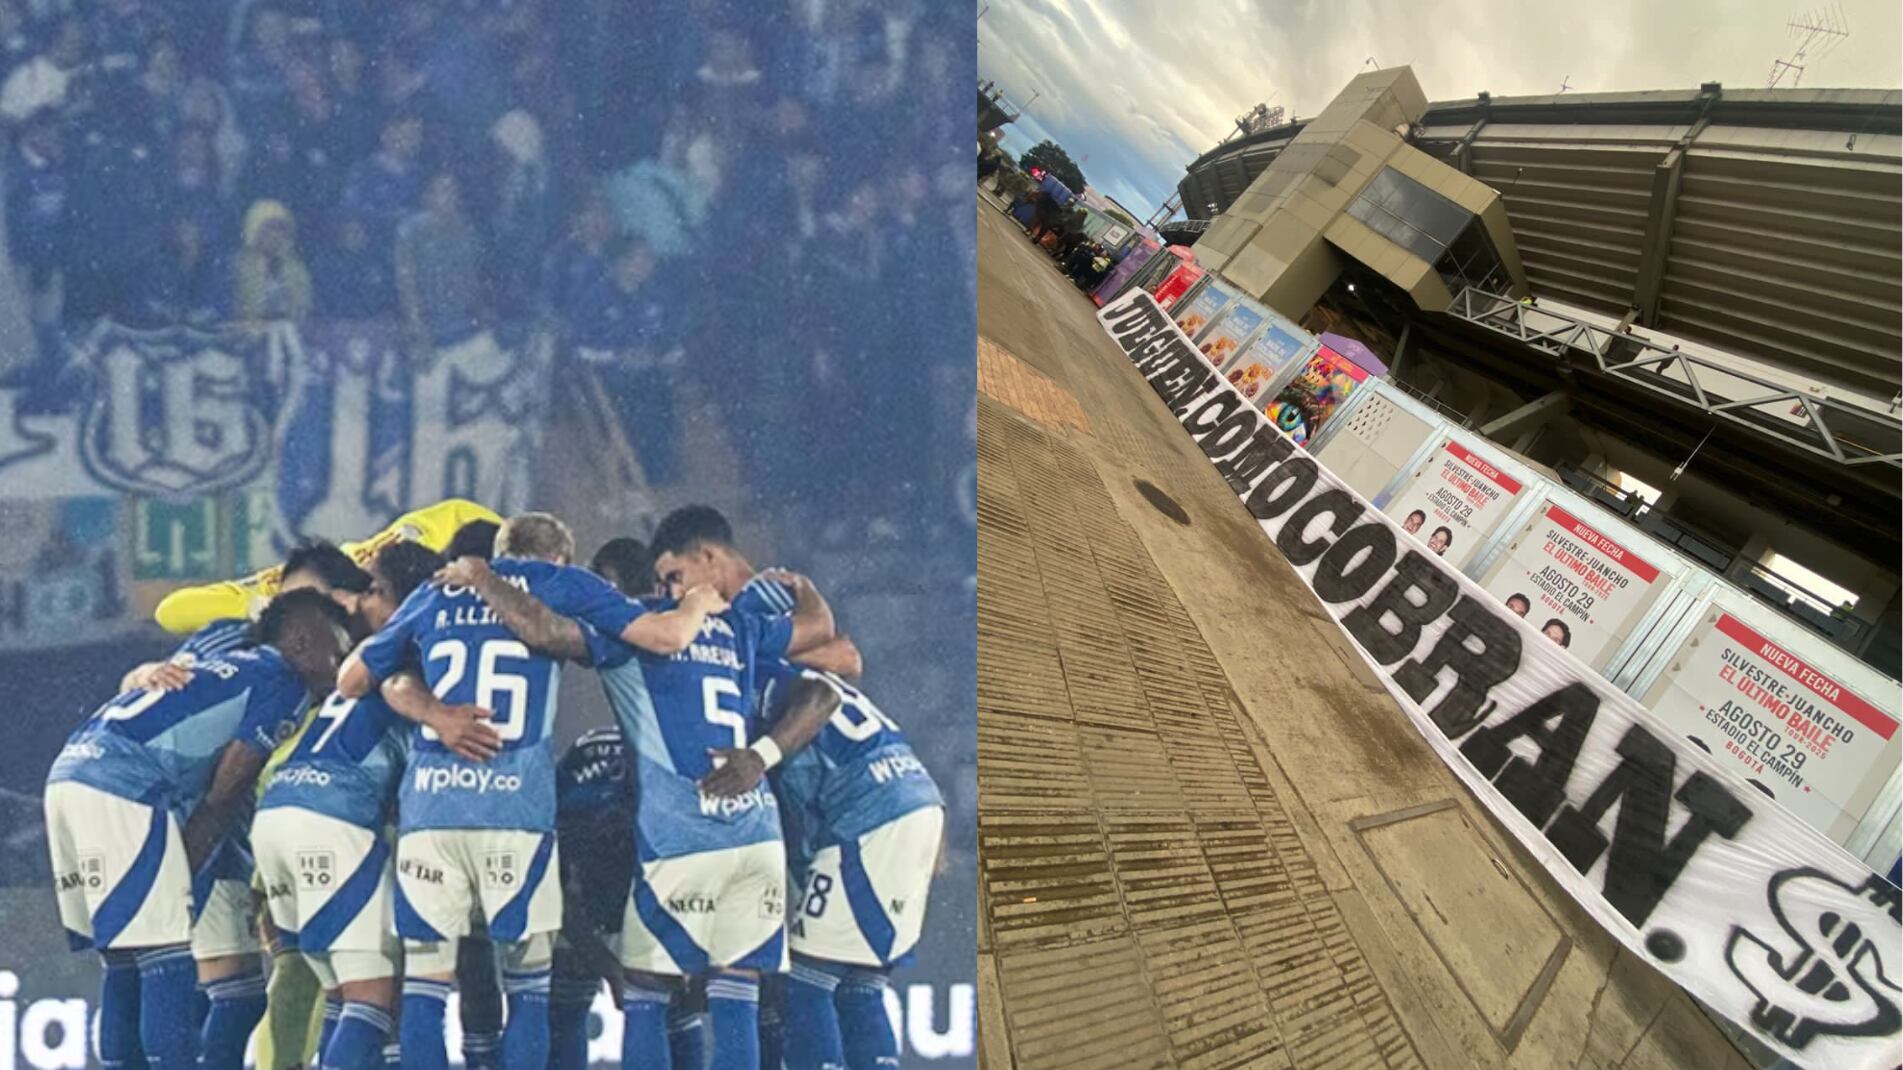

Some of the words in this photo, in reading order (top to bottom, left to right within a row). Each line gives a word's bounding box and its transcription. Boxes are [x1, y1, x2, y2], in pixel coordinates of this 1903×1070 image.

[1181, 389, 1319, 520] COMO
[1436, 487, 1463, 510] AGOSTO
[1460, 504, 1473, 518] 29
[1573, 524, 1598, 545] NUEVA
[1597, 539, 1624, 560] FECHA
[1530, 573, 1557, 596] ESTADIO
[1539, 565, 1579, 599] AGOSTO
[1576, 591, 1594, 609] 29
[1585, 569, 1616, 594] BAILE
[421, 639, 531, 741] 26
[1759, 643, 1802, 674] NUEVA
[1799, 668, 1840, 702] FECHA
[702, 676, 747, 770] 5
[1718, 664, 1737, 685] EL
[1786, 710, 1836, 751] BAILE
[1718, 699, 1781, 751] AGOSTO
[1779, 743, 1807, 770] 29
[1705, 708, 1748, 745] ESTADIO
[1746, 741, 1760, 756] EL
[1760, 750, 1804, 788] CAMPÍN
[1725, 740, 1765, 775] BOGOTÁ
